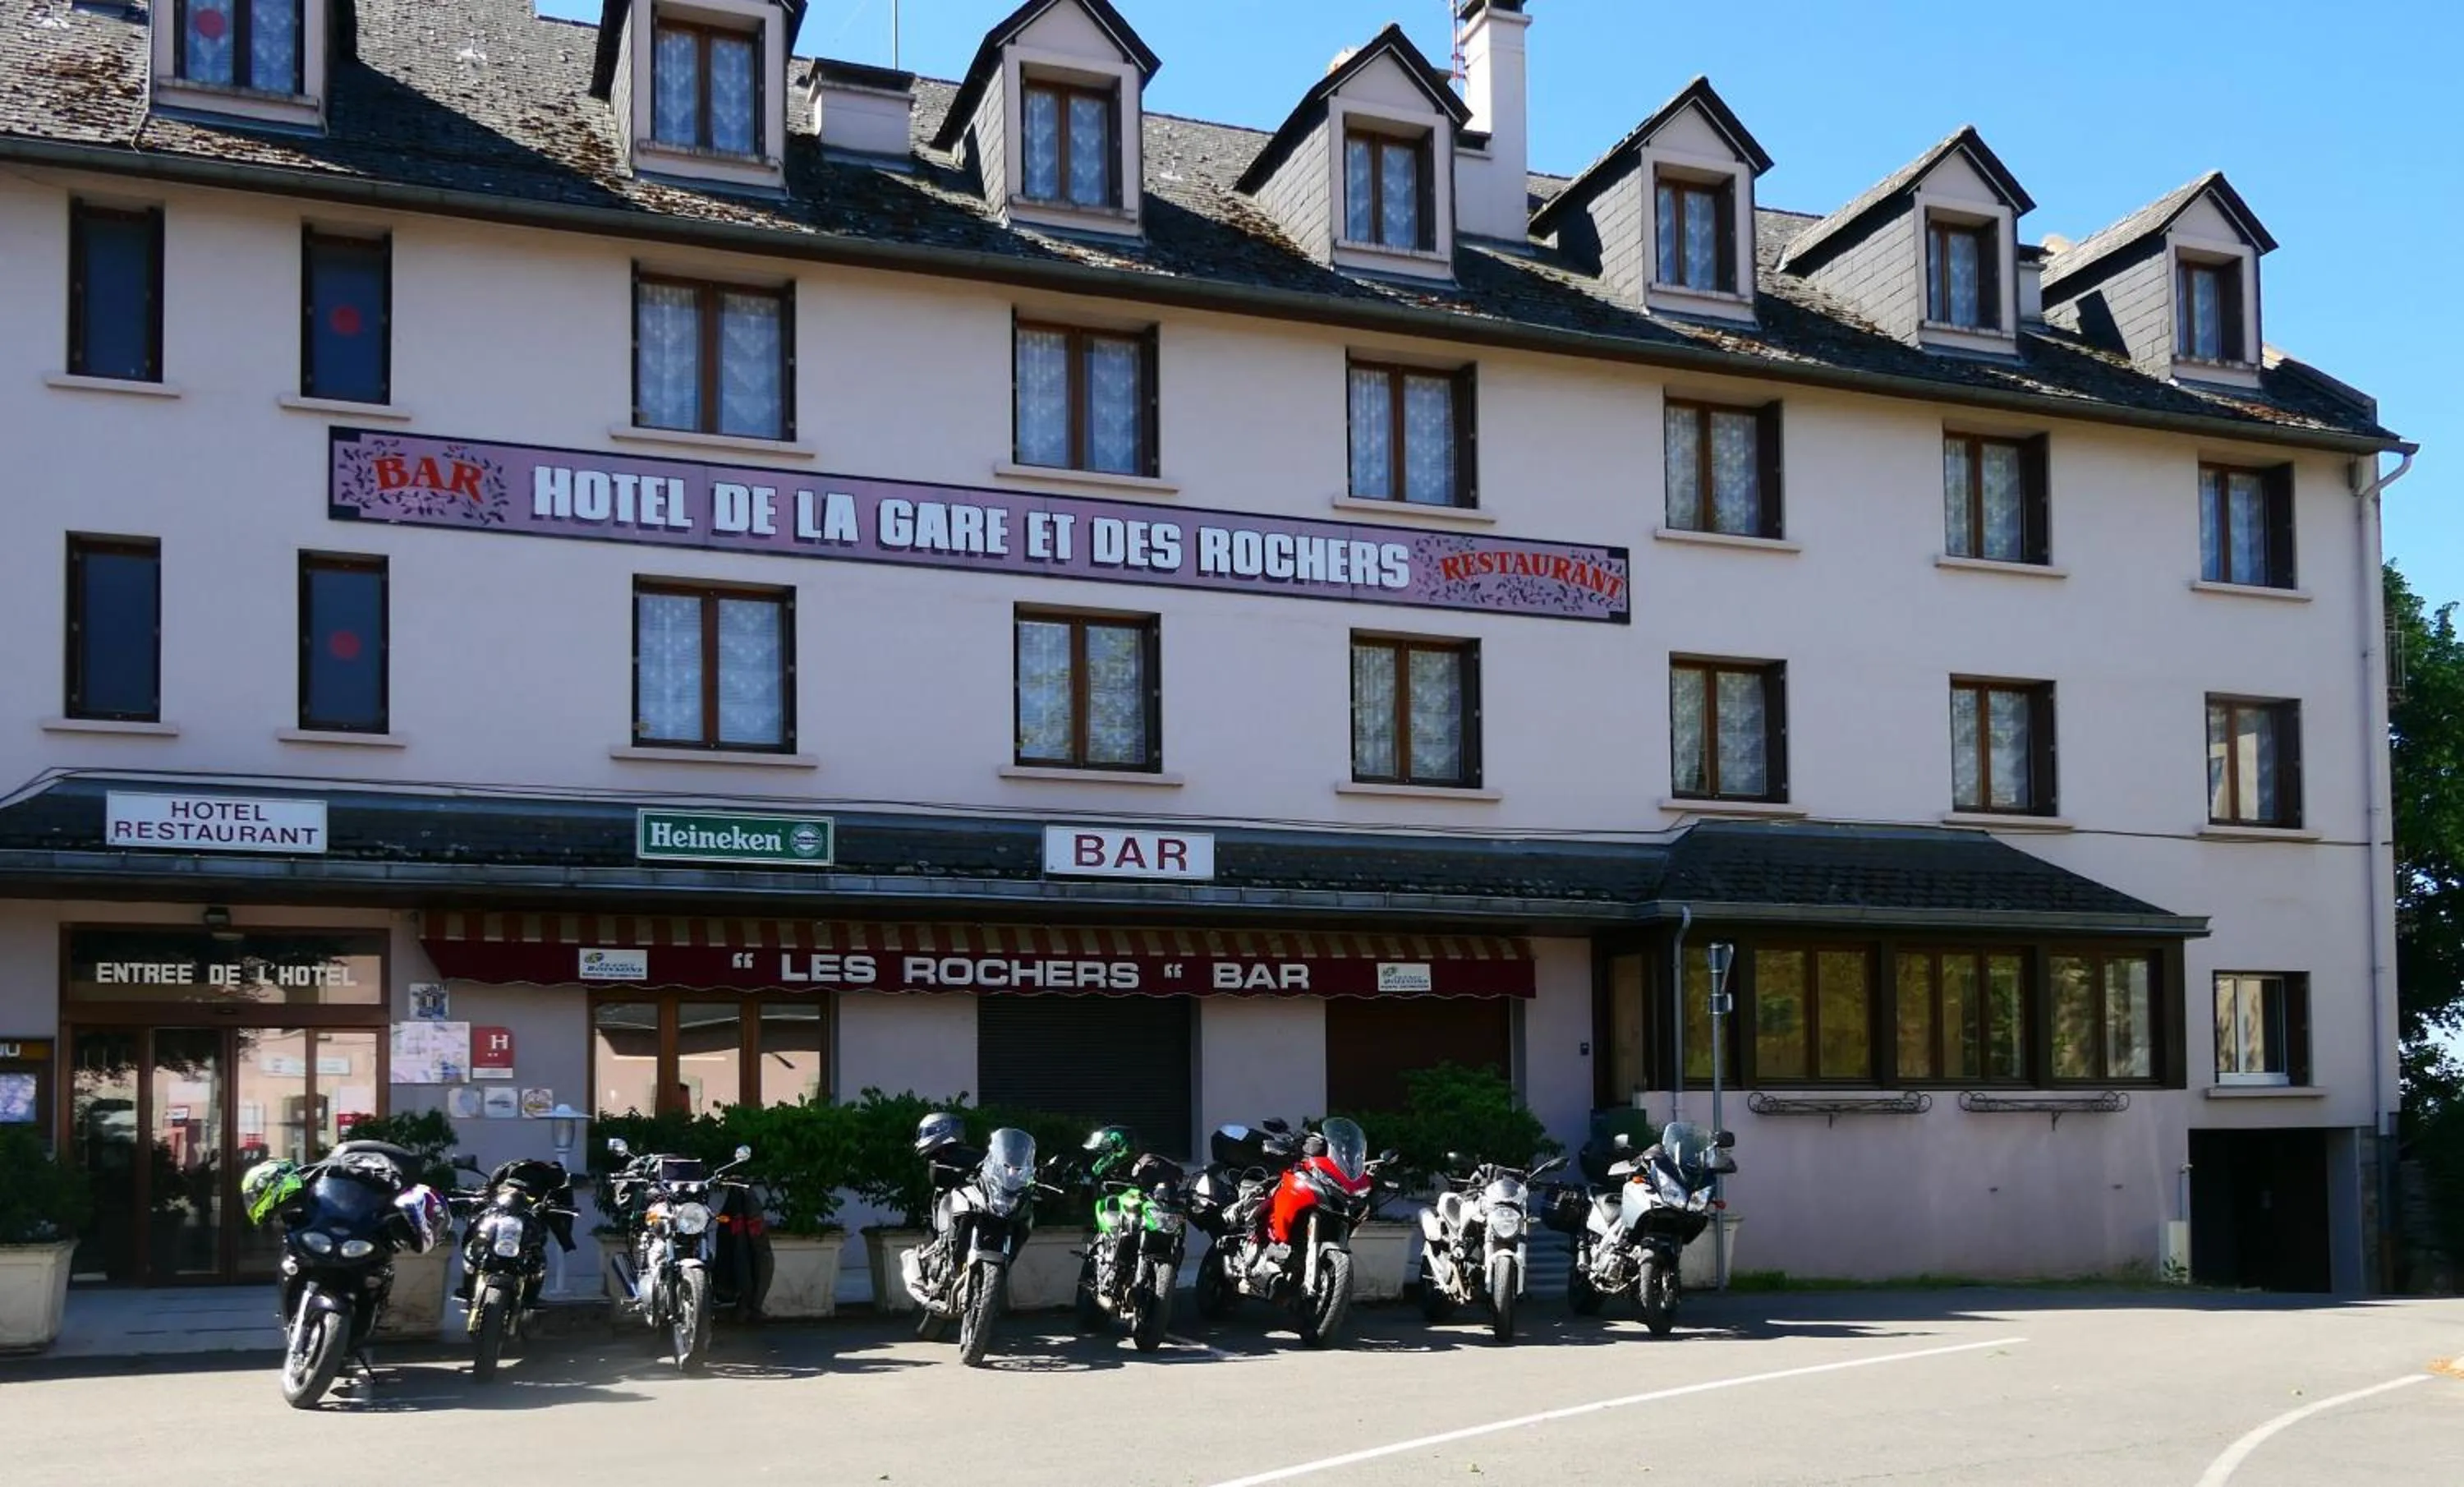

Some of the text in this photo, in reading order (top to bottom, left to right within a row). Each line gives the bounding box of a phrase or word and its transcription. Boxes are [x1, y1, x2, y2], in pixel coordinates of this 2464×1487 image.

[371, 455, 485, 504] BAR
[533, 465, 1410, 589] HOTEL DE LA GARE ET DES ROCHERS
[1439, 550, 1625, 600] RESTAURANT
[171, 800, 269, 822] HOTEL
[114, 820, 319, 845] RESTAURANT
[650, 822, 783, 852] Heineken
[1074, 833, 1187, 872] BAR
[95, 961, 357, 987] ENTREE DE L'HOTEL
[781, 954, 876, 983] LES
[903, 955, 1140, 988] ROCHERS
[1212, 962, 1311, 990] BAR
[491, 1034, 509, 1049] H
